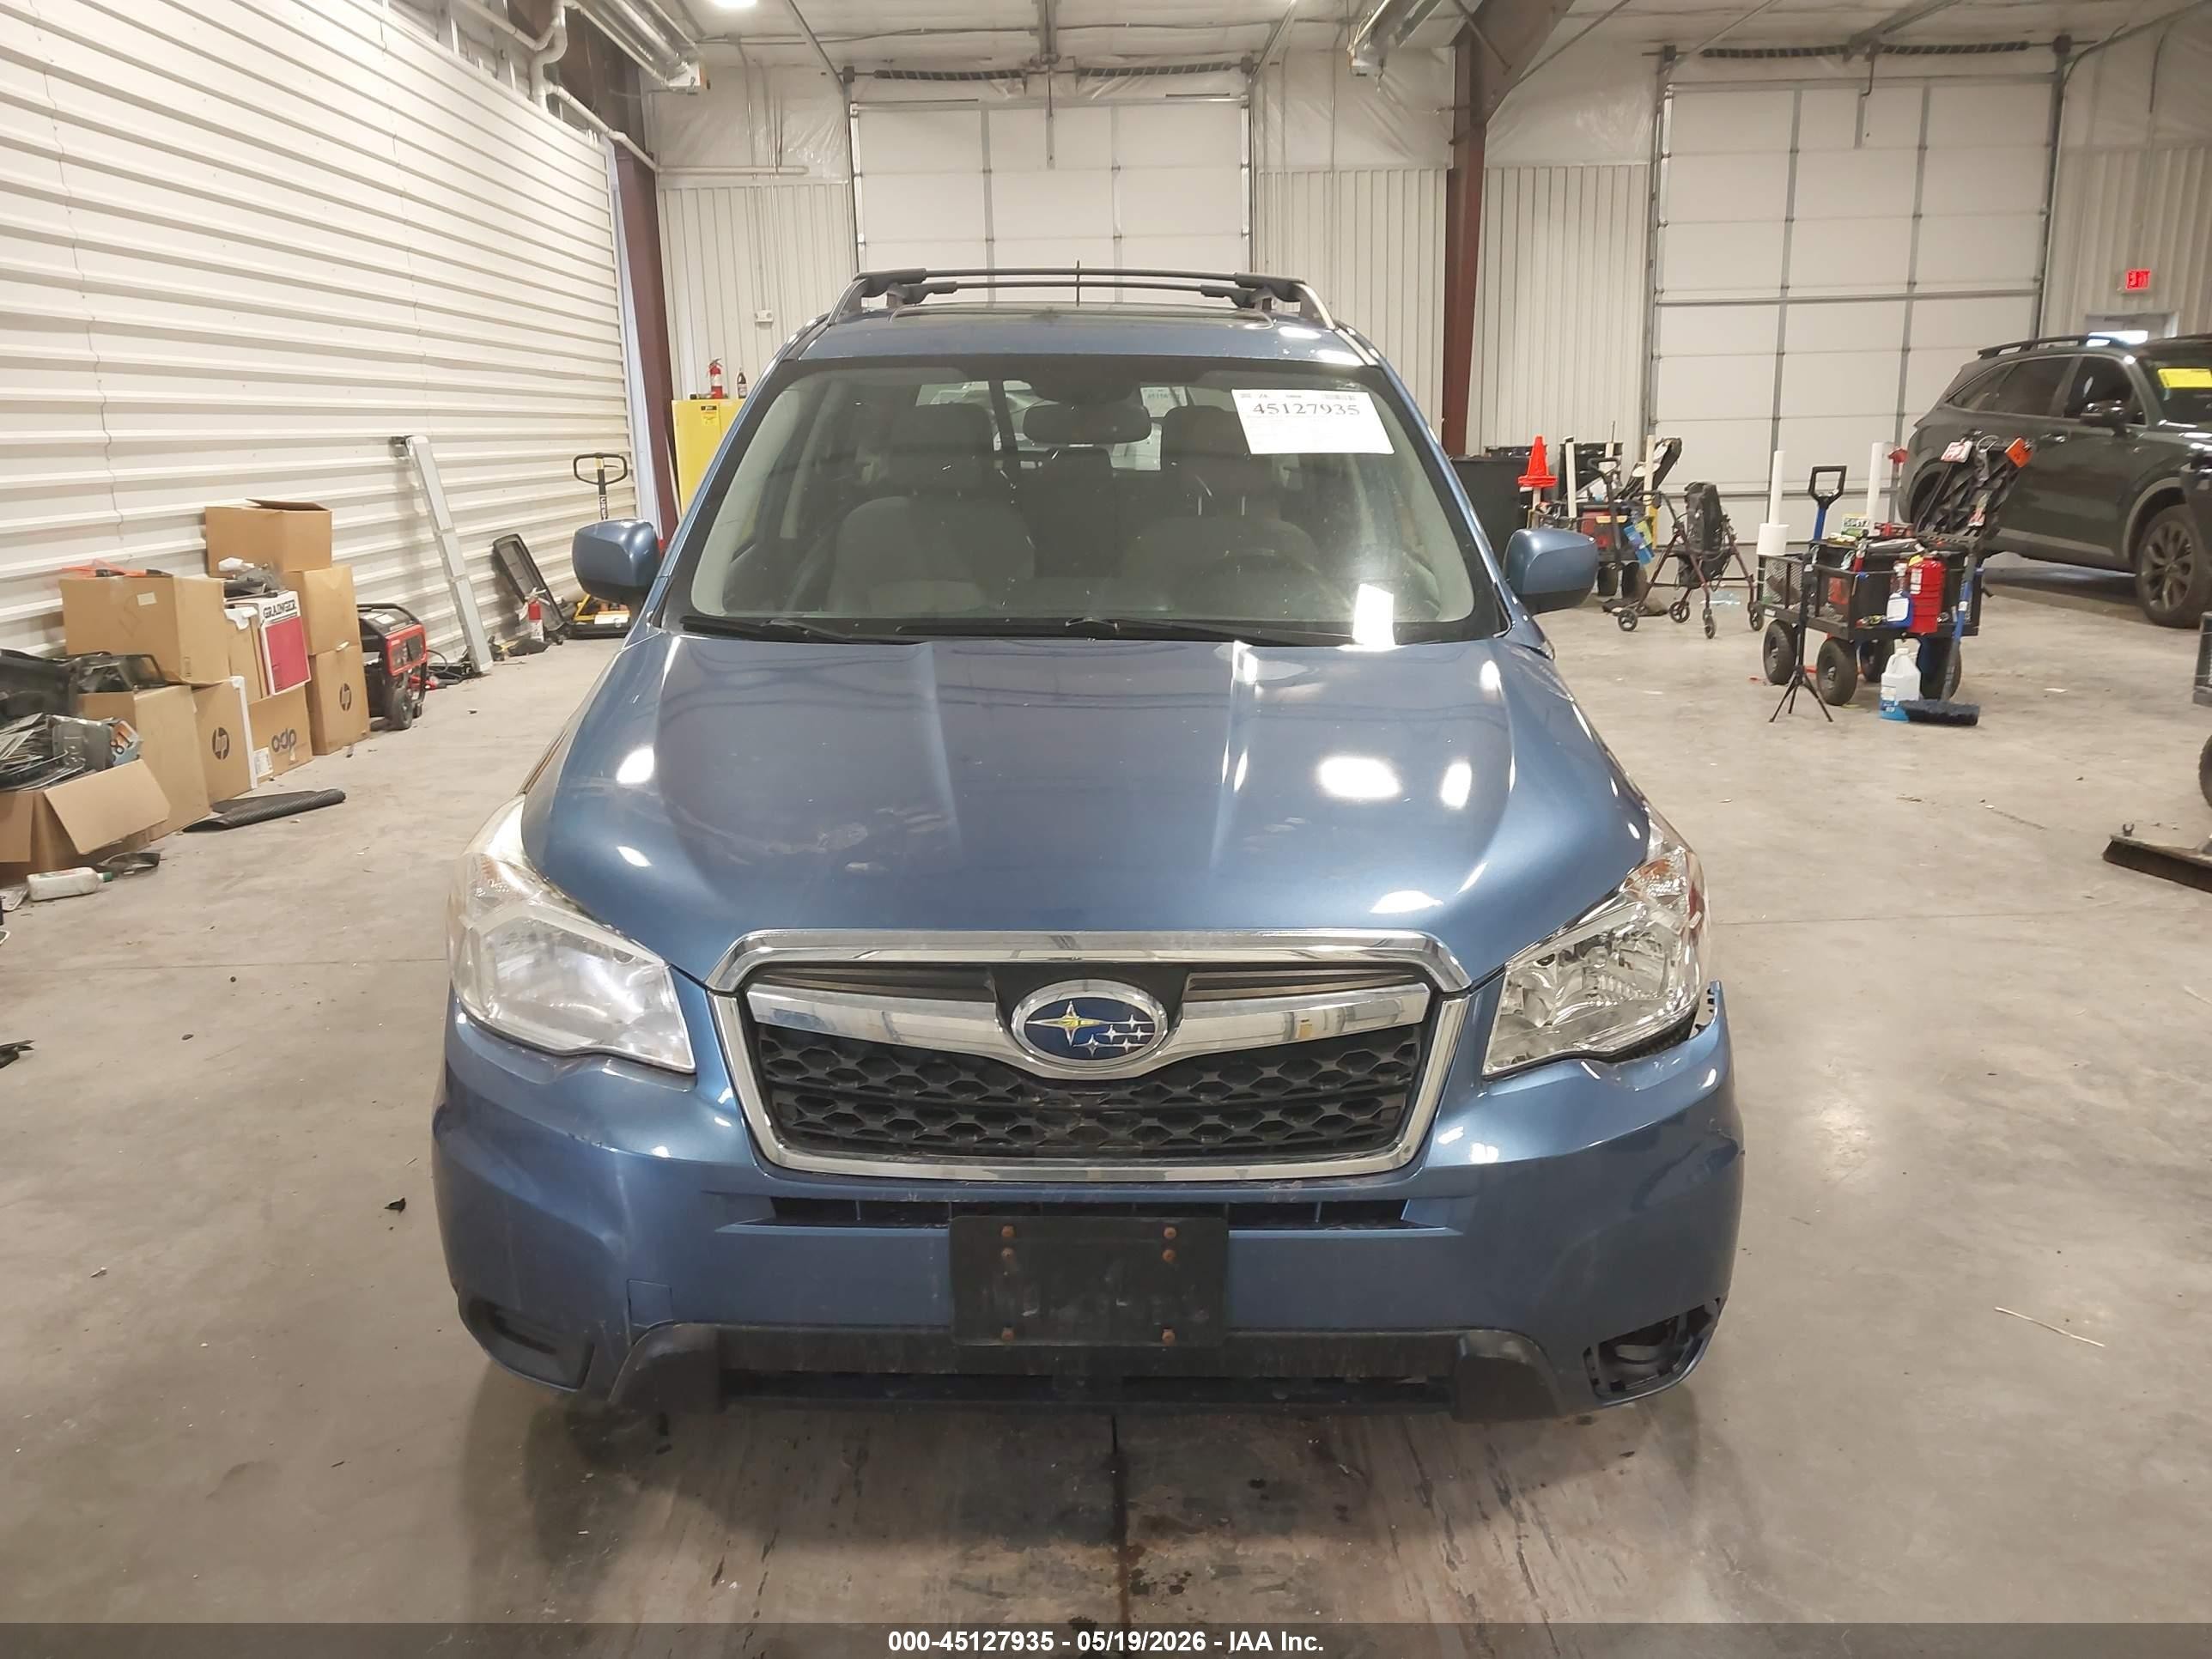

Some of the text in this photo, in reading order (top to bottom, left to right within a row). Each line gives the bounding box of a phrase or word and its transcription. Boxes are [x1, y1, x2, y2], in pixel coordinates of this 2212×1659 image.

[1252, 401, 1360, 416] 45127935
[263, 599, 297, 618] GRAINGER
[211, 726, 230, 760] hp
[271, 728, 297, 753] odp
